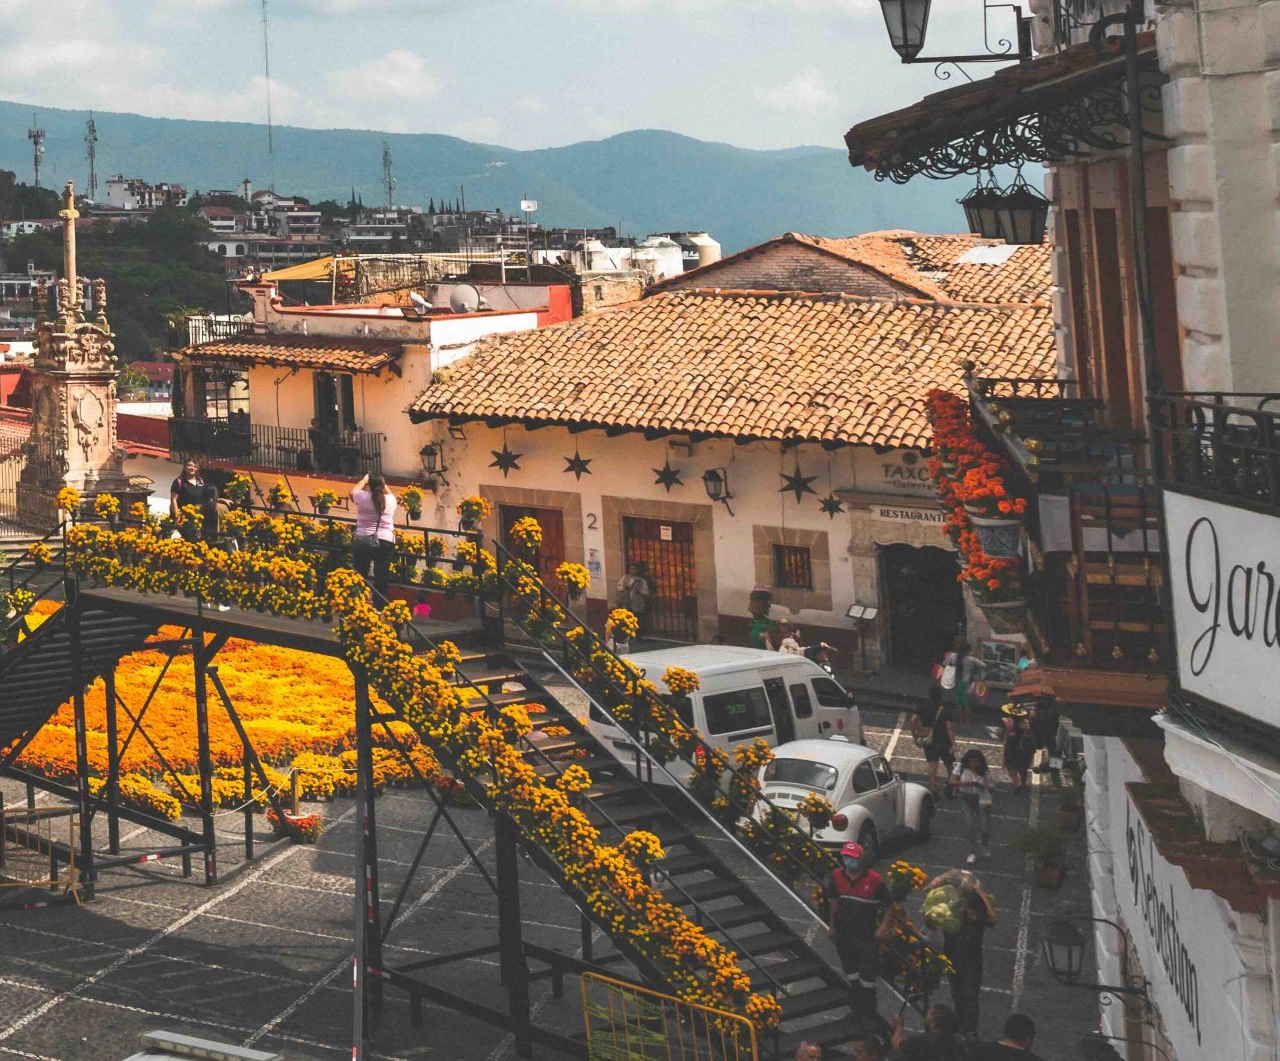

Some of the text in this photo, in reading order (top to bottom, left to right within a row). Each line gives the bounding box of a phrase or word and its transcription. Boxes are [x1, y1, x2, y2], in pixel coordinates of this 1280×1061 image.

[881, 463, 929, 482] TAXC
[586, 512, 599, 530] 2
[1185, 516, 1280, 677] Jar
[1137, 818, 1202, 1047] Sebastian
